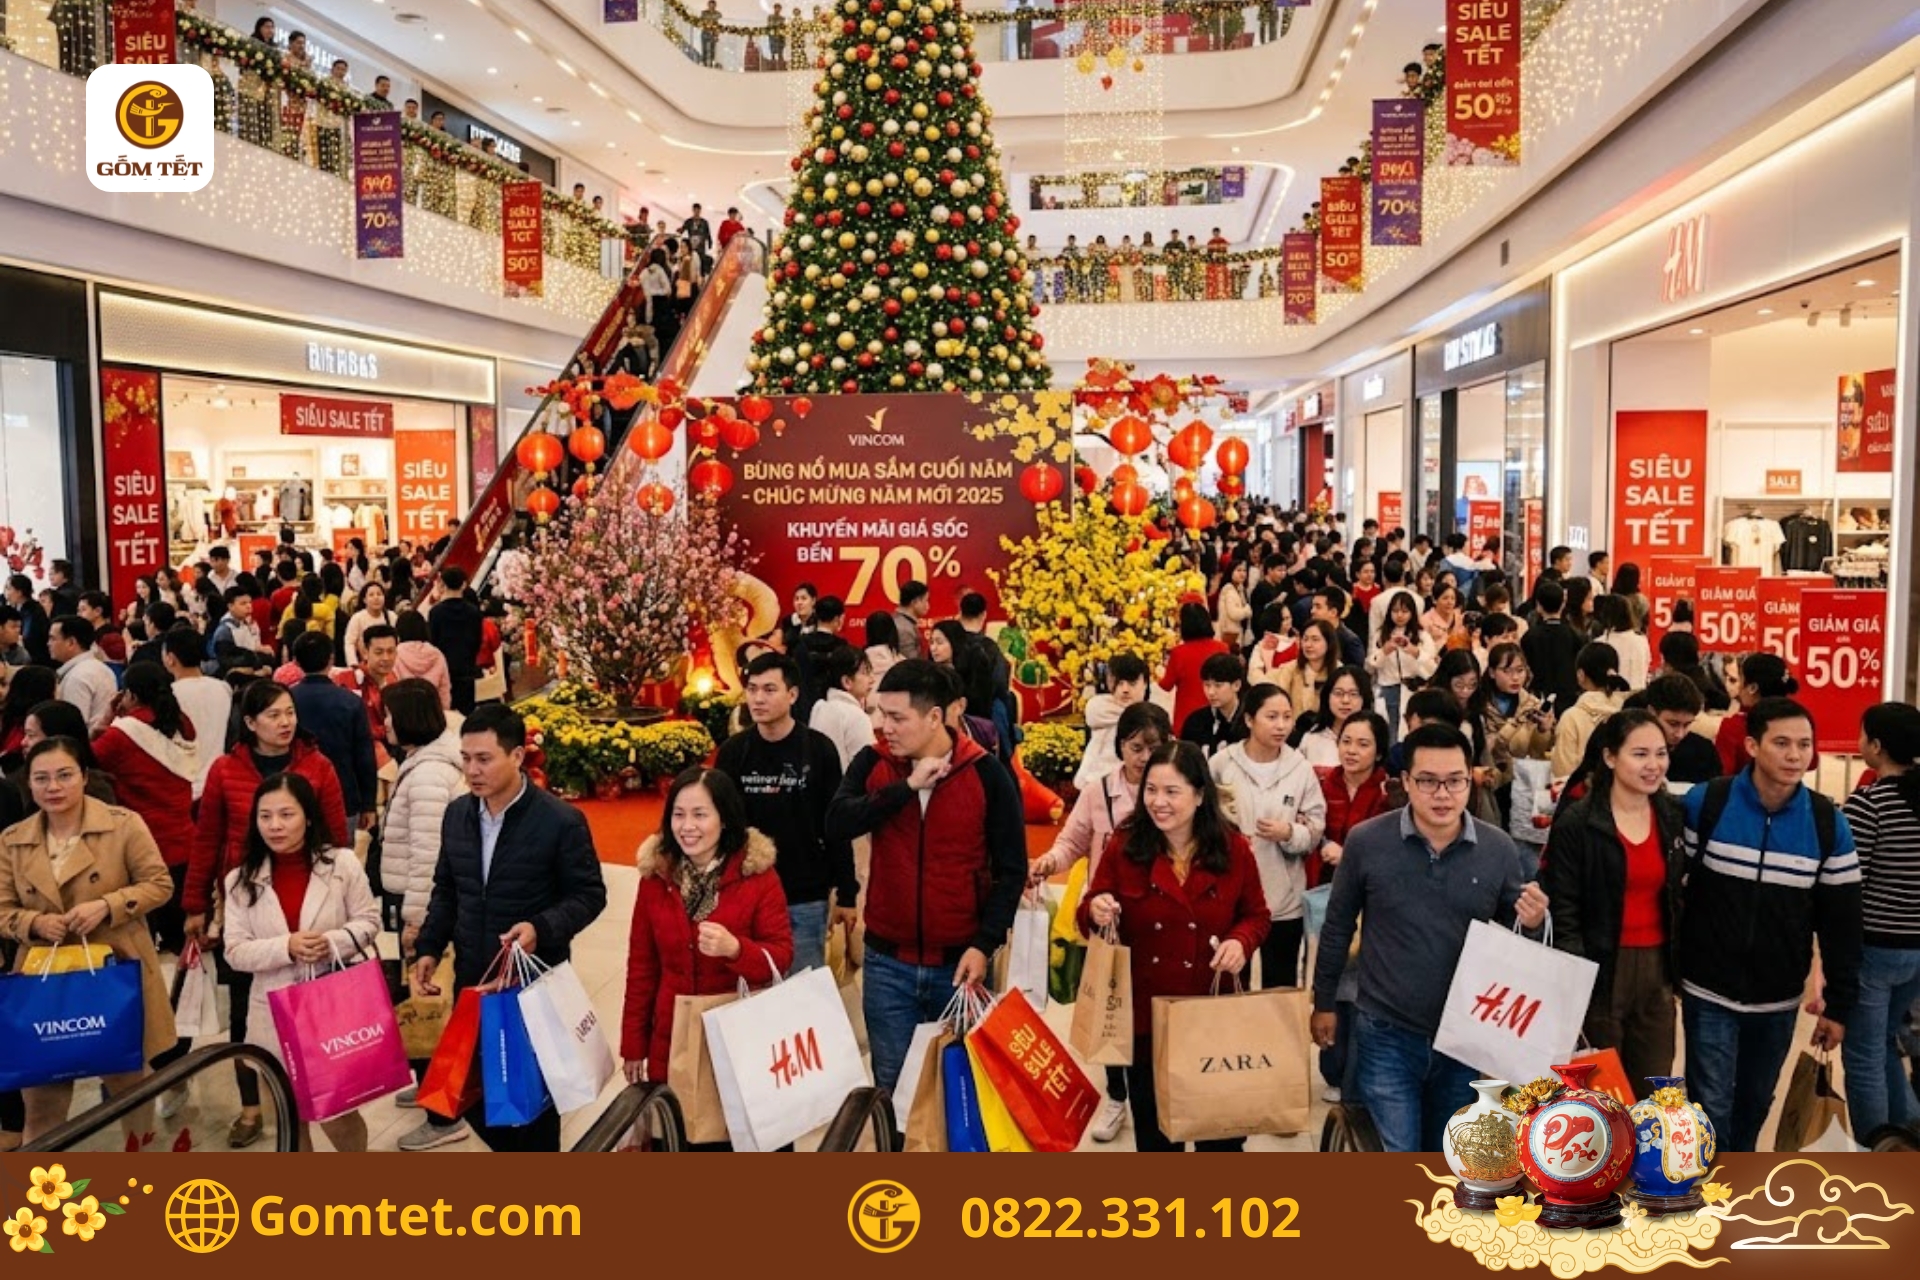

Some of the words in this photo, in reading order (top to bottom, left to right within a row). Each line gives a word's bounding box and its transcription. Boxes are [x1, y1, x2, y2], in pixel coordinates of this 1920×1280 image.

[125, 31, 167, 51] SIÊU
[1455, 23, 1512, 43] SALE
[1463, 43, 1504, 66] TẾT
[329, 409, 361, 429] SALE
[847, 434, 905, 446] VINCOM
[829, 462, 870, 480] MUA
[920, 455, 965, 480] CUỐI
[1628, 453, 1692, 478] SIÊU
[113, 470, 156, 496] SIÊU
[401, 484, 451, 501] SALE
[956, 486, 1004, 504] 2025
[1625, 485, 1695, 506] SALE
[112, 503, 159, 526] SALE
[787, 516, 858, 537] KHUYẾN
[898, 517, 929, 537] GIÁ
[931, 516, 969, 537] SỐC
[1625, 507, 1694, 546] TẾT
[114, 530, 159, 567] TẾT
[839, 544, 961, 606] 70%
[1808, 612, 1850, 632] GIẢM
[1853, 614, 1881, 632] GIÁ
[1470, 982, 1542, 1038] H&M
[33, 1014, 106, 1035] VINCOM
[320, 1022, 385, 1055] VINCOM
[769, 1026, 824, 1090] H&M
[1199, 1053, 1273, 1073] ZARA
